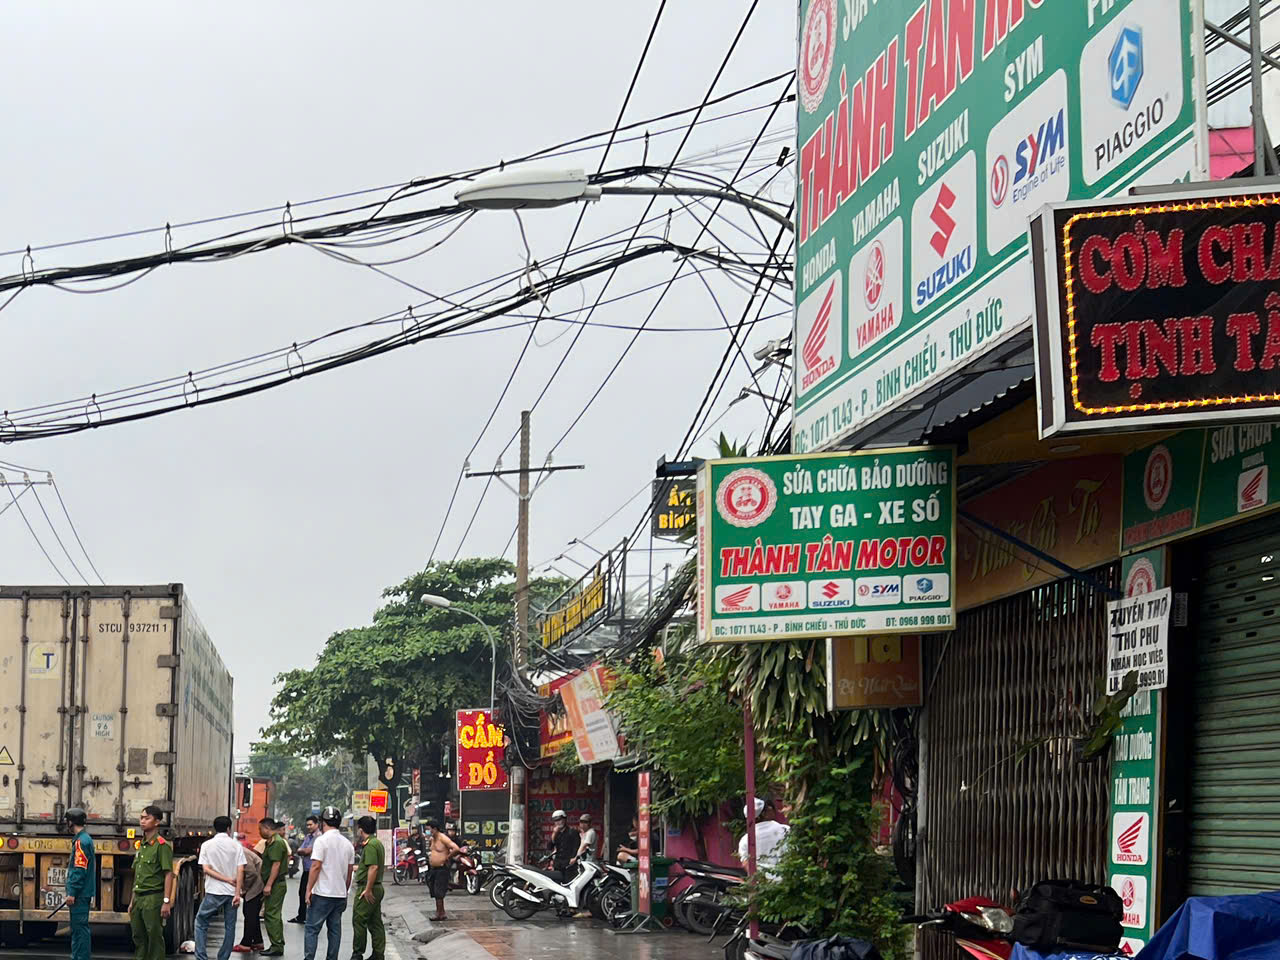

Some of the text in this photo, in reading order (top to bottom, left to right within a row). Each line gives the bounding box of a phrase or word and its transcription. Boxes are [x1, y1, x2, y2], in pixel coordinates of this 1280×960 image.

[1004, 35, 1044, 102] SYM
[799, 34, 899, 248] THÀNH
[917, 108, 969, 185] SUZUKI
[1012, 108, 1064, 185] SYM
[1094, 97, 1164, 171] PIAGGIO
[1012, 155, 1065, 203] Engine of Life
[851, 176, 901, 246] YAMAHA
[802, 236, 837, 293] HONDA
[917, 245, 971, 305] SUZUKI
[1078, 219, 1187, 294] CƠM
[856, 302, 894, 350] YAMAHA
[802, 355, 835, 391] HONDA
[810, 413, 829, 446] 1071
[832, 398, 853, 433] TL43
[975, 298, 1003, 343] ĐỨC
[1090, 315, 1216, 399] TỊNH
[783, 458, 948, 495] SỬA CHỮA BẢO DƯỠNG
[790, 505, 824, 530] TAY
[830, 503, 857, 528] GA
[878, 500, 905, 525] XE
[911, 489, 940, 523] SỐ
[720, 537, 802, 578] THÀNH
[806, 533, 854, 573] TÂN
[855, 535, 947, 570] MOTOR
[768, 601, 800, 609] YAMAHA
[812, 599, 850, 607] SUZUKI
[871, 584, 900, 594] SYM
[909, 594, 942, 602] PIAGGIO
[99, 623, 122, 633] STCU
[729, 625, 747, 635] 1071
[749, 624, 767, 634] TL43
[899, 616, 918, 627] 0968
[920, 615, 935, 626] 999
[936, 614, 951, 625] 901
[1140, 624, 1159, 648] PHỤ
[1128, 777, 1150, 804] TRANG
[28, 840, 53, 850] LONG
[1116, 854, 1143, 863] HONDA
[1122, 913, 1140, 926] MAHA
